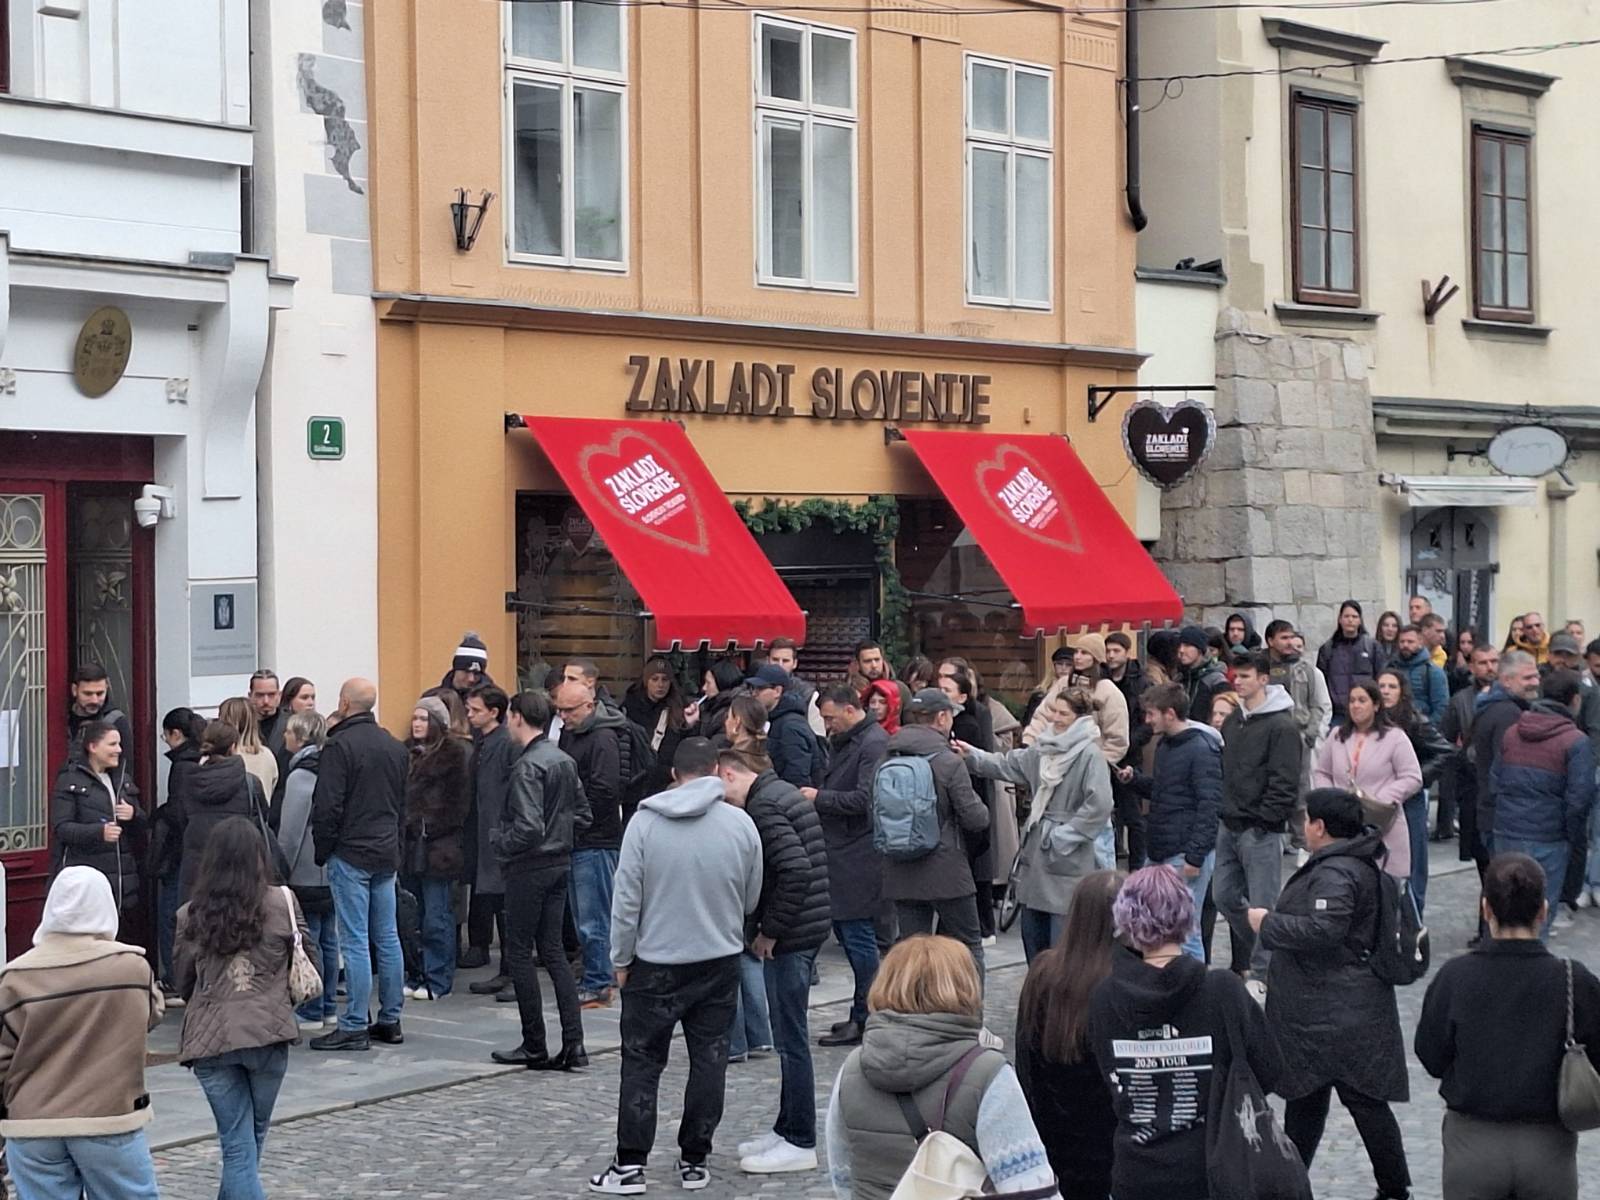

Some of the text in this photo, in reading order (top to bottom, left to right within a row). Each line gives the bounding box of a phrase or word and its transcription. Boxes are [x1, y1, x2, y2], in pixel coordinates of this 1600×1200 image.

[625, 355, 991, 425] ZAKLADI SLOVENIJE
[324, 424, 331, 444] 2
[1145, 431, 1188, 444] ZAKLADI
[604, 454, 664, 497] ZAKLADI
[619, 470, 681, 514] SLOVENIJE
[997, 467, 1039, 509] ZAKLADI
[1135, 1056, 1188, 1069] 2026 TOUR
